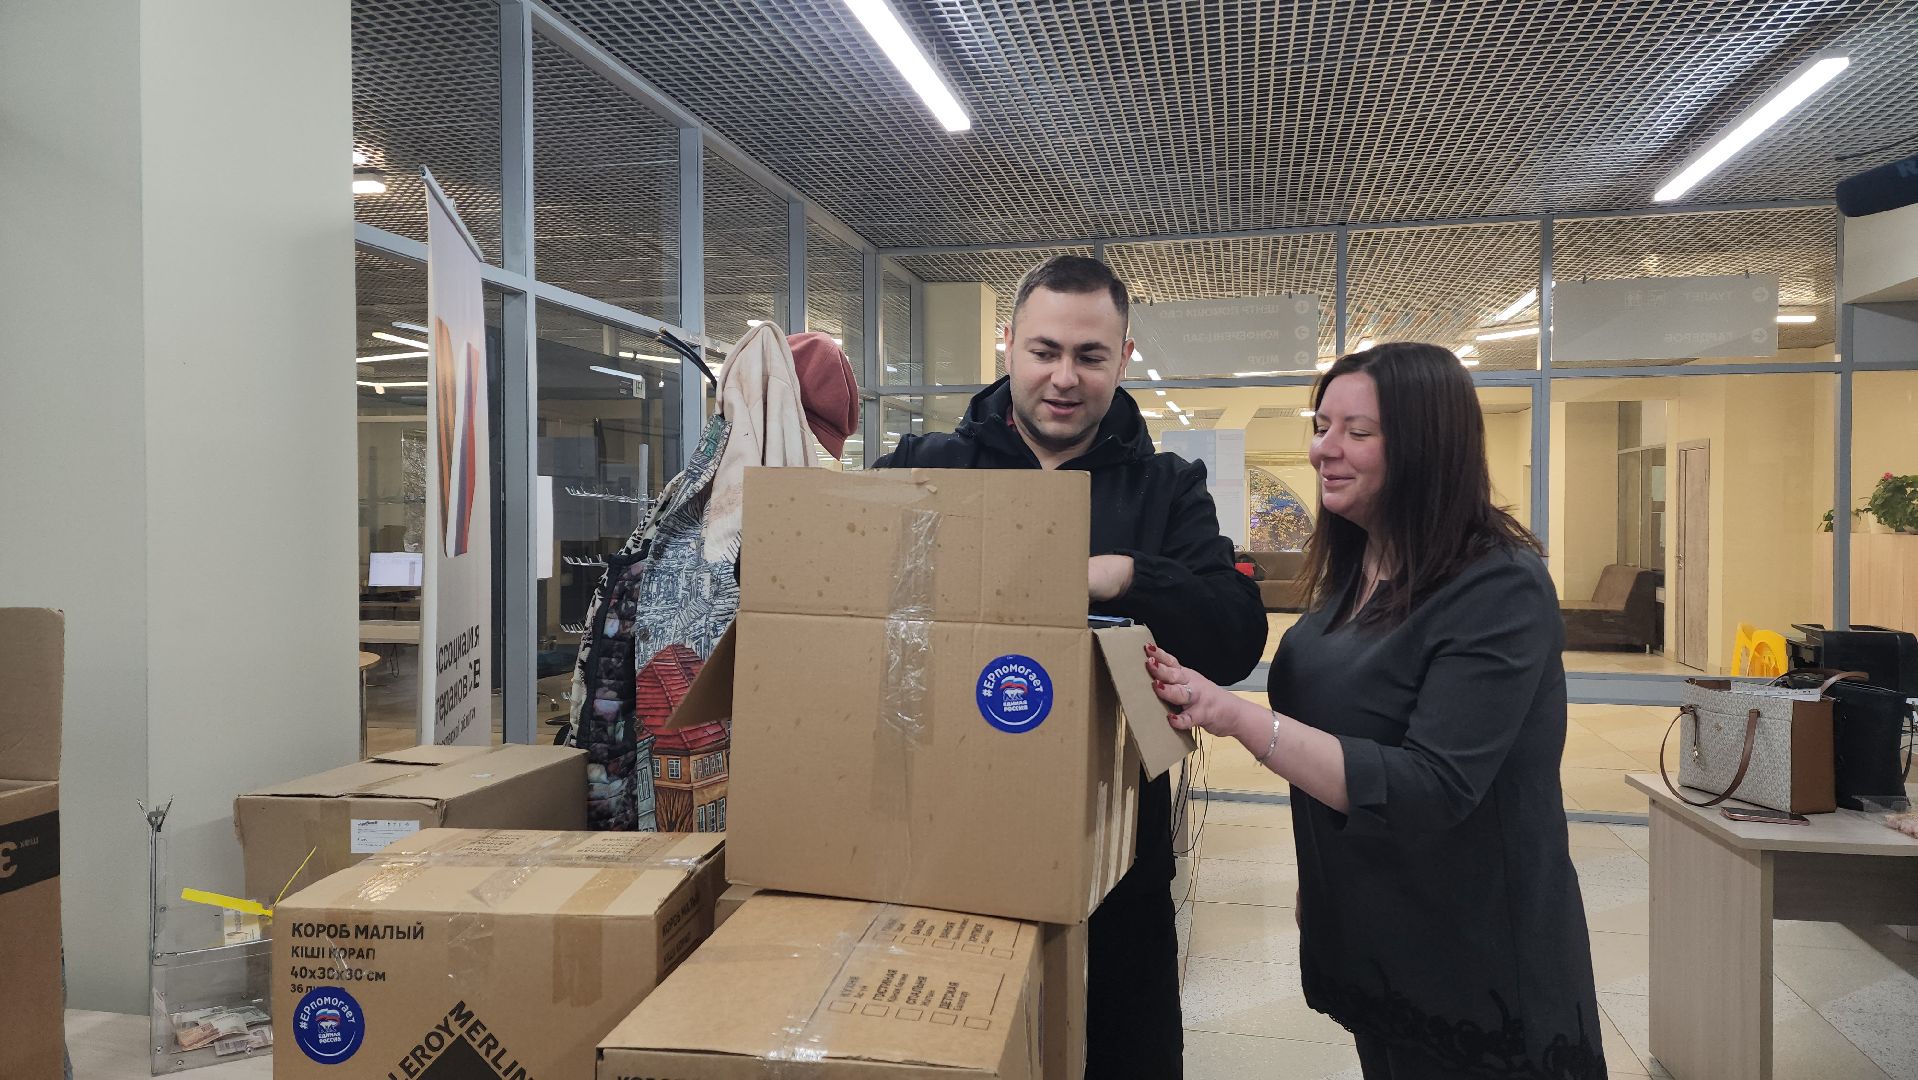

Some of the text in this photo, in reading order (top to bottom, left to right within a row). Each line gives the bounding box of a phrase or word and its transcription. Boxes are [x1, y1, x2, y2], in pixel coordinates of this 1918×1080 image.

[292, 921, 424, 940] КОРОБ МАЛЫЙ
[366, 971, 386, 982] см
[290, 983, 303, 993] 36
